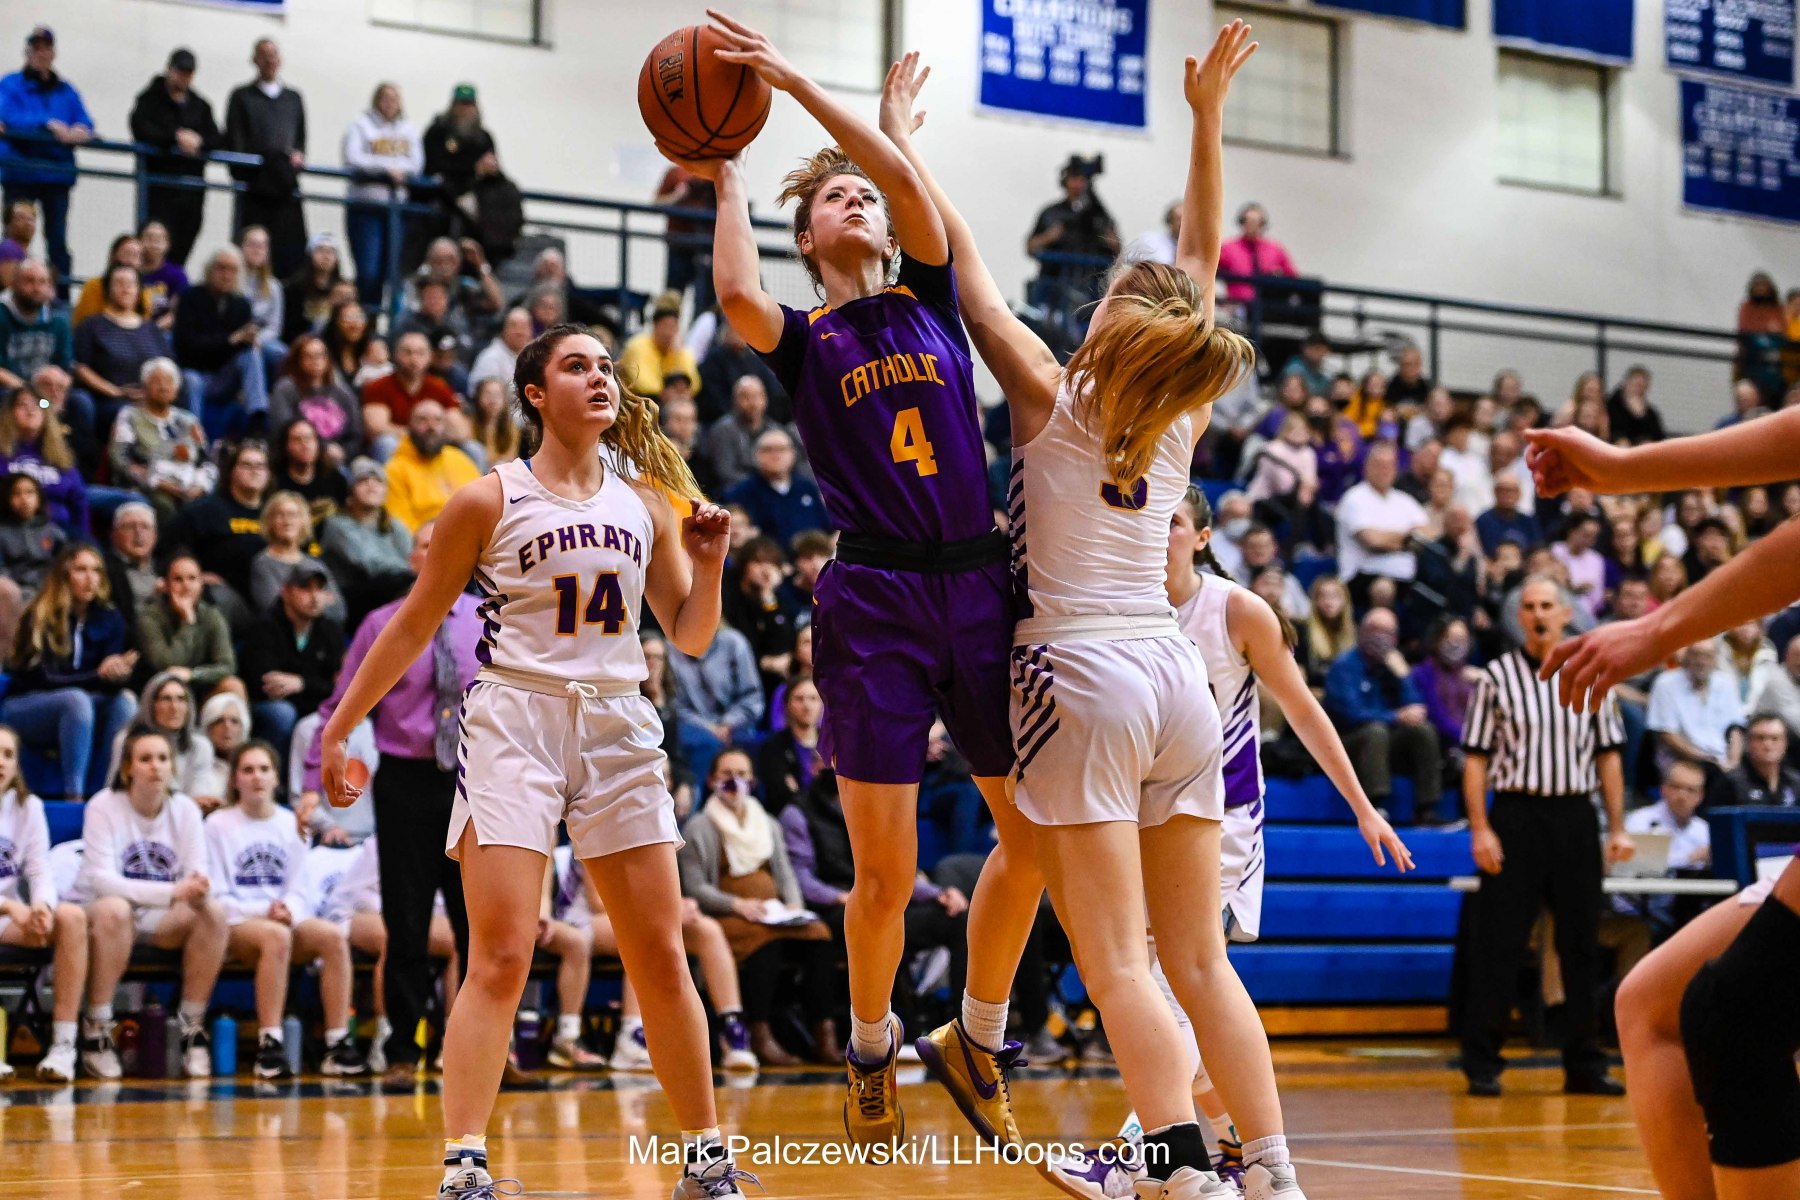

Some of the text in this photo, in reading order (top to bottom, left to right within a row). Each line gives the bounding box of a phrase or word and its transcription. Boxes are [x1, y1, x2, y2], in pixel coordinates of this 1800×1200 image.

[840, 352, 946, 408] CATHOLIC
[889, 406, 938, 477] 4
[517, 523, 643, 576] EPHRATA
[551, 570, 629, 638] 14
